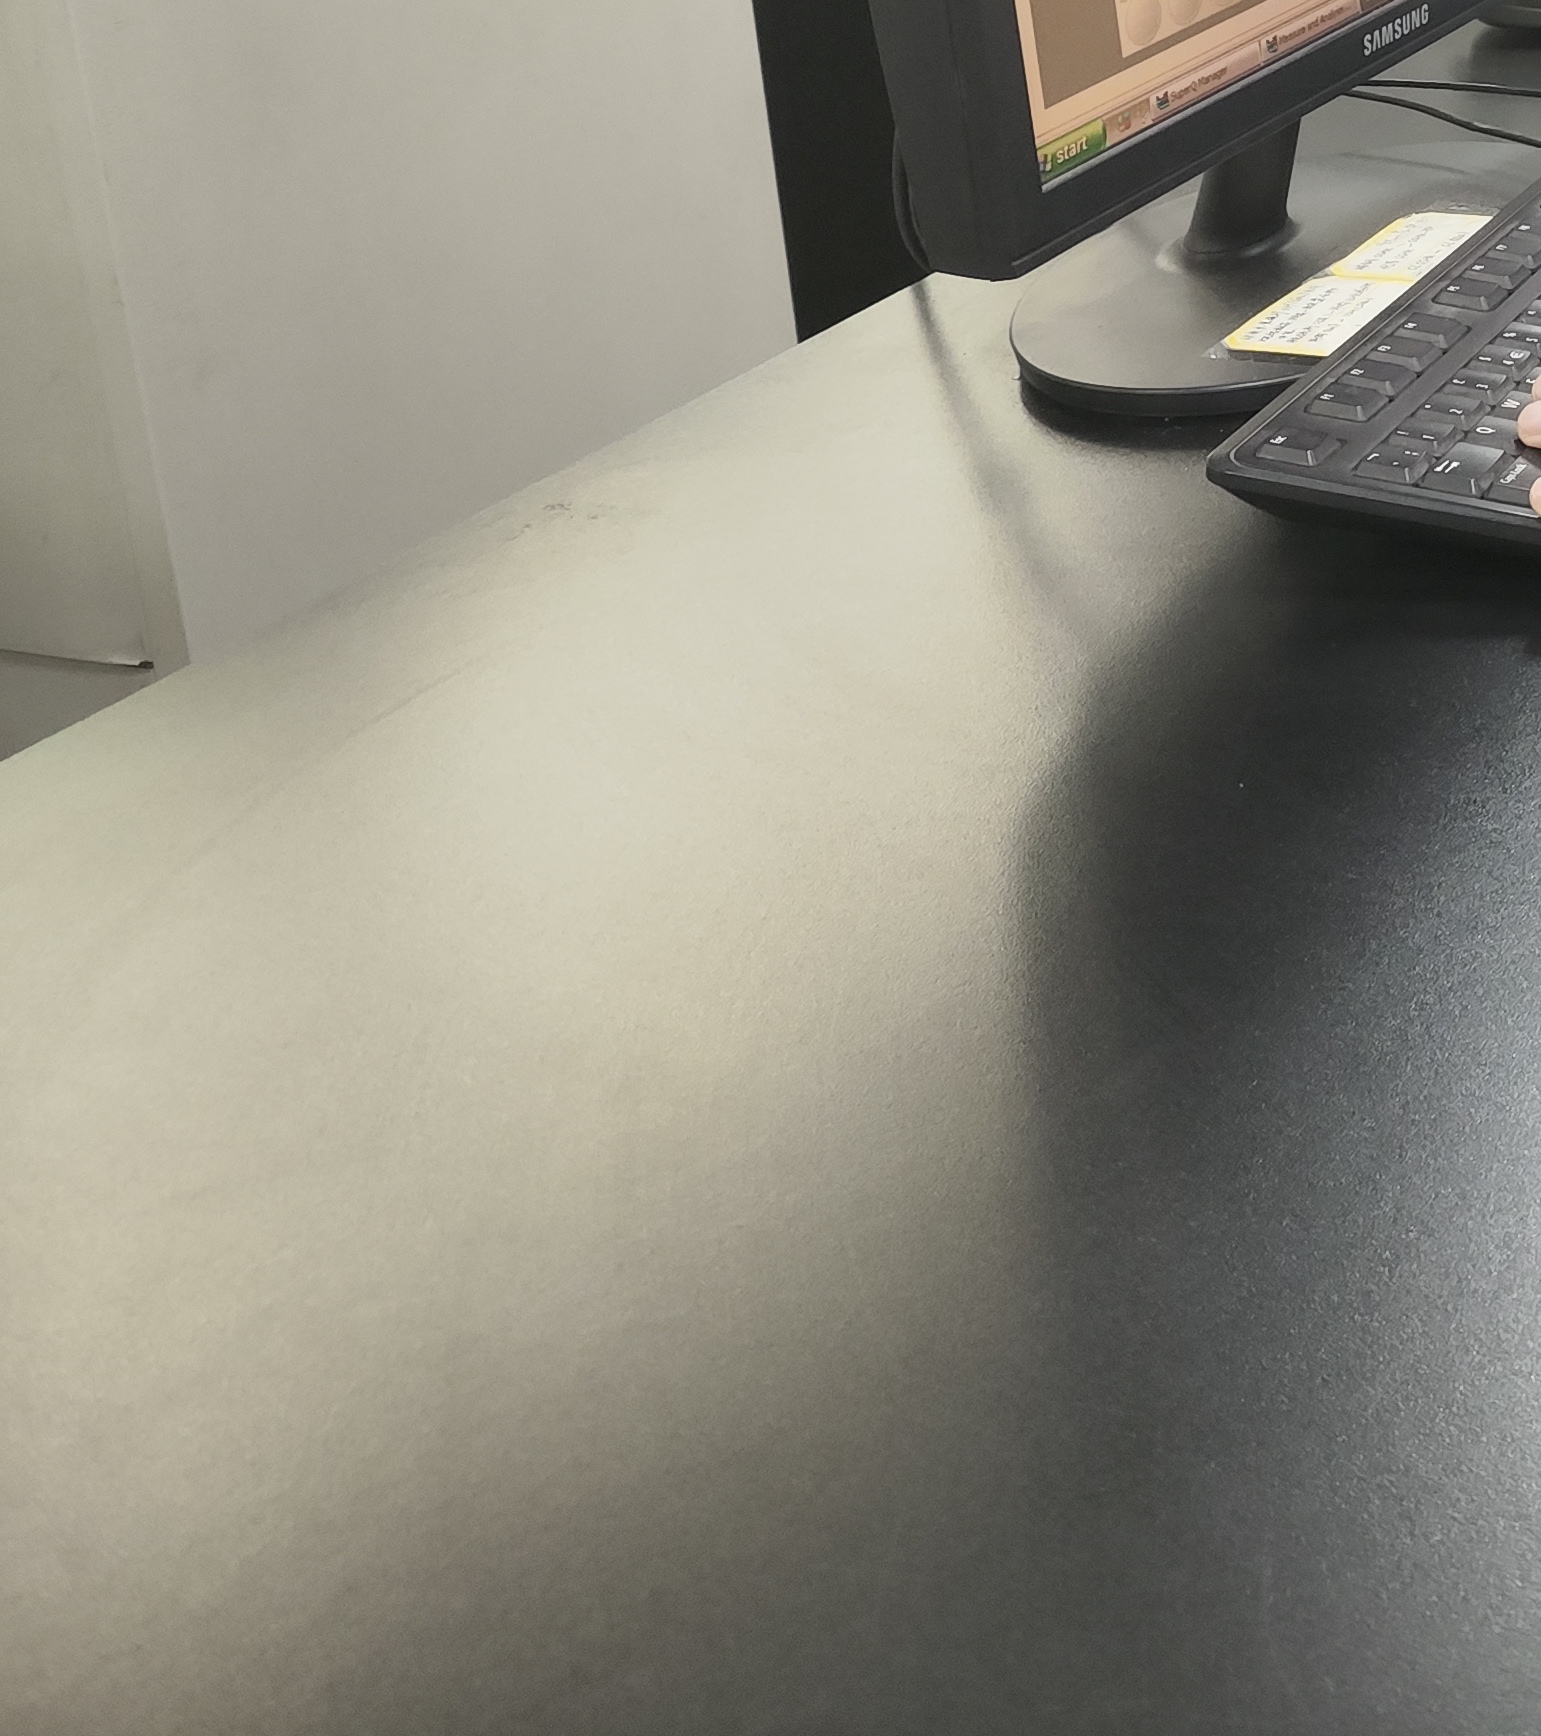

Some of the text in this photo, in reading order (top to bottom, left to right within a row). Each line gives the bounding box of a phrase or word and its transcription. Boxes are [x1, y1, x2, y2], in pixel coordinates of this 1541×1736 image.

[1362, 3, 1431, 57] SAMSUNG
[1199, 65, 1229, 91] Manager
[1056, 135, 1089, 166] start
[1377, 344, 1392, 352] F3
[1350, 368, 1364, 376] F2
[1501, 398, 1521, 408] W
[1476, 426, 1496, 434] Q
